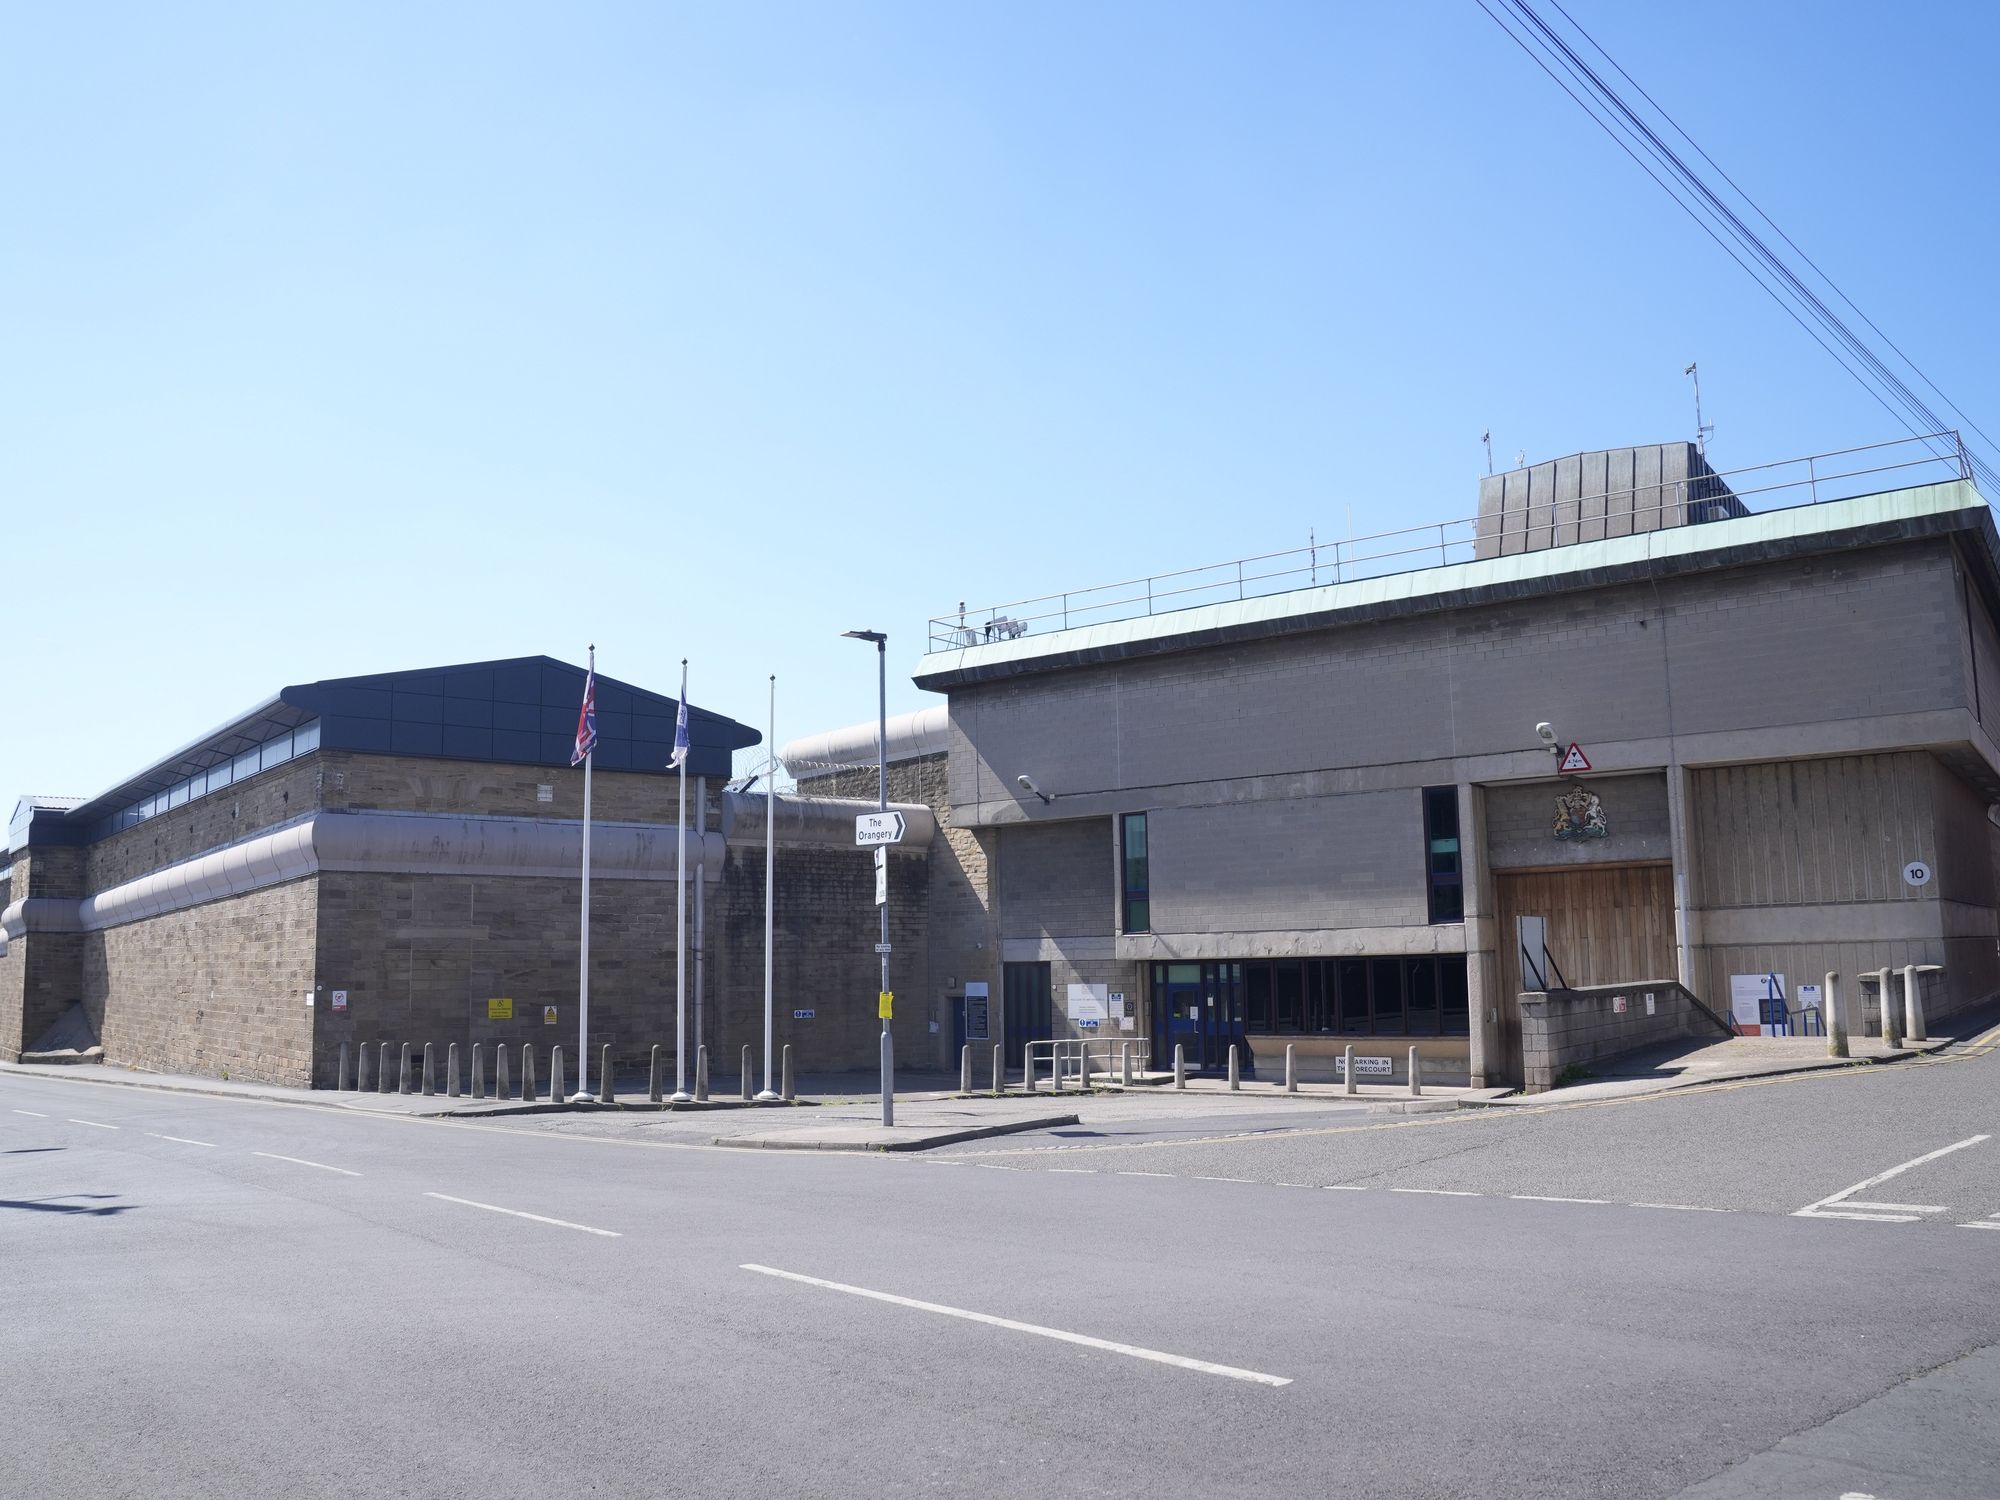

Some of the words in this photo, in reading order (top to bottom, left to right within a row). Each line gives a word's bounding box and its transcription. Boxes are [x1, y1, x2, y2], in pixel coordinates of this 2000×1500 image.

[869, 818, 881, 826] The
[858, 830, 892, 840] Orangery
[1910, 869, 1923, 879] 10
